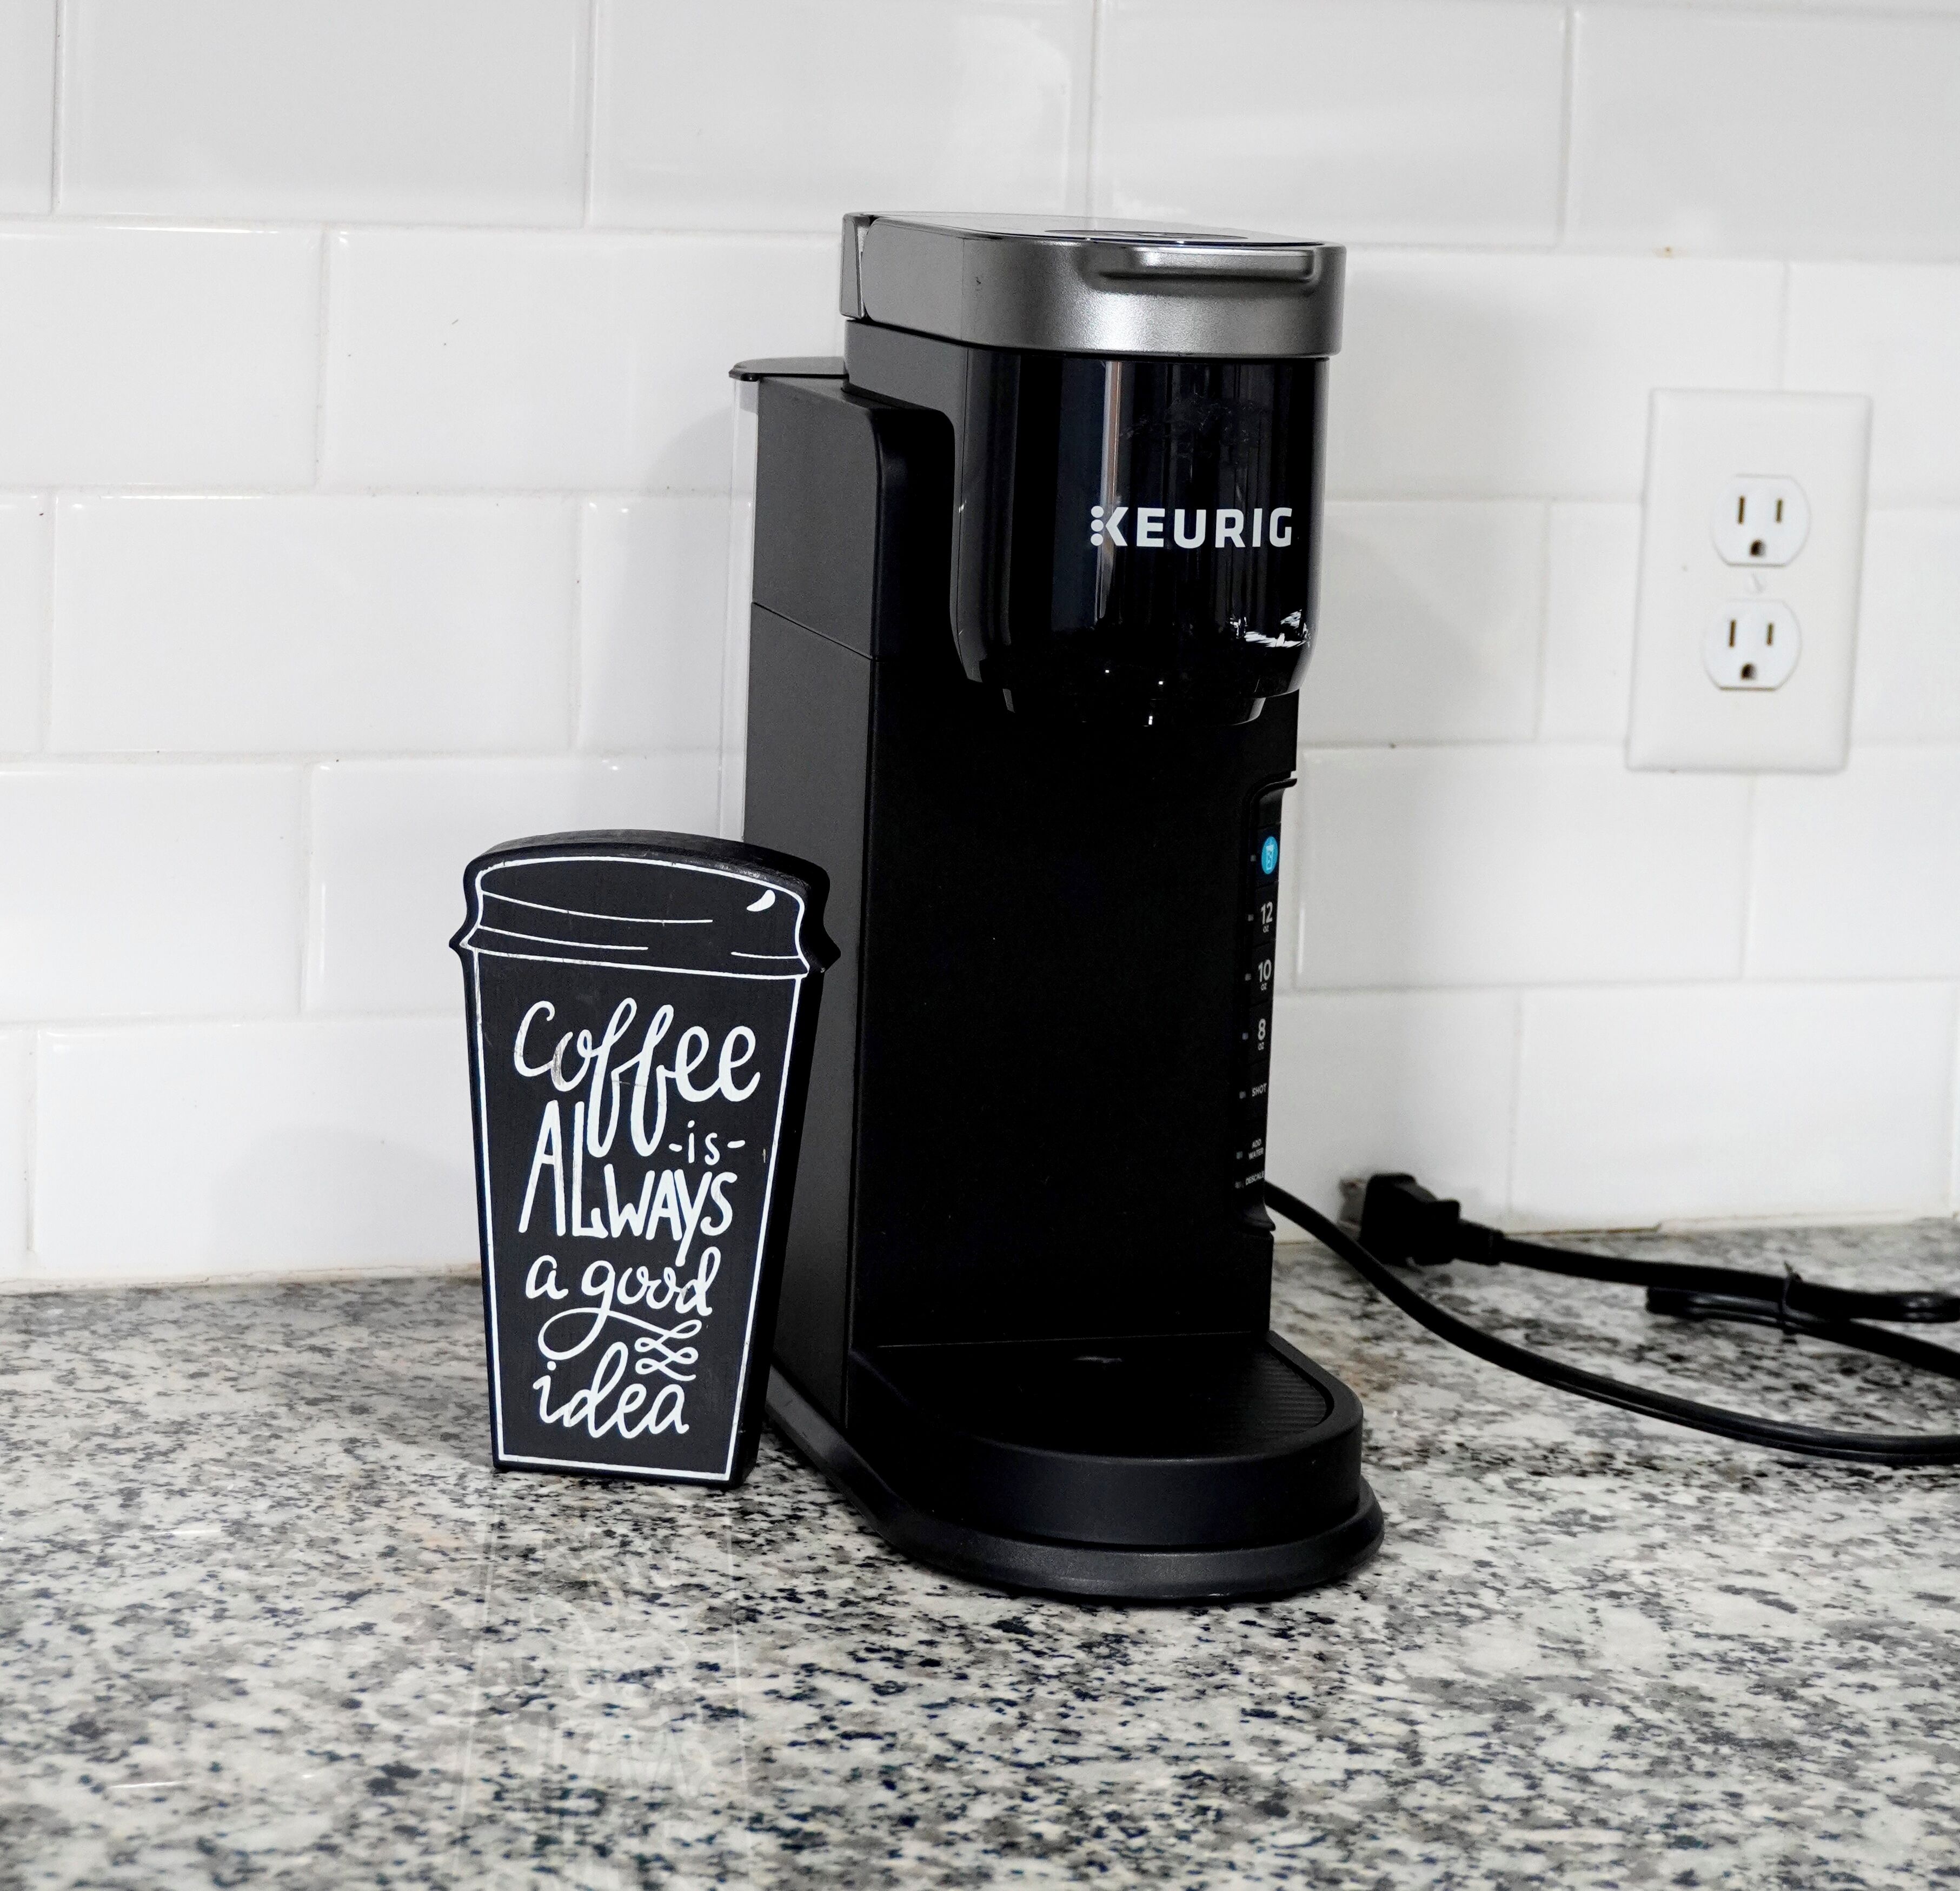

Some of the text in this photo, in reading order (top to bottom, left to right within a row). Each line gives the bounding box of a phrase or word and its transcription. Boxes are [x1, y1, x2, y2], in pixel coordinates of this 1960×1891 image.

[1091, 505, 1292, 548] KEURIG
[1261, 901, 1273, 925] 12
[1258, 959, 1272, 982] 10
[1258, 1018, 1266, 1041] 8
[514, 998, 760, 1157] Coffee
[1252, 1083, 1267, 1097] SHOT
[1248, 1147, 1264, 1160] WATER
[1245, 1170, 1265, 1186] DESCALE
[526, 1247, 721, 1360] a good
[533, 1342, 689, 1439] idea
